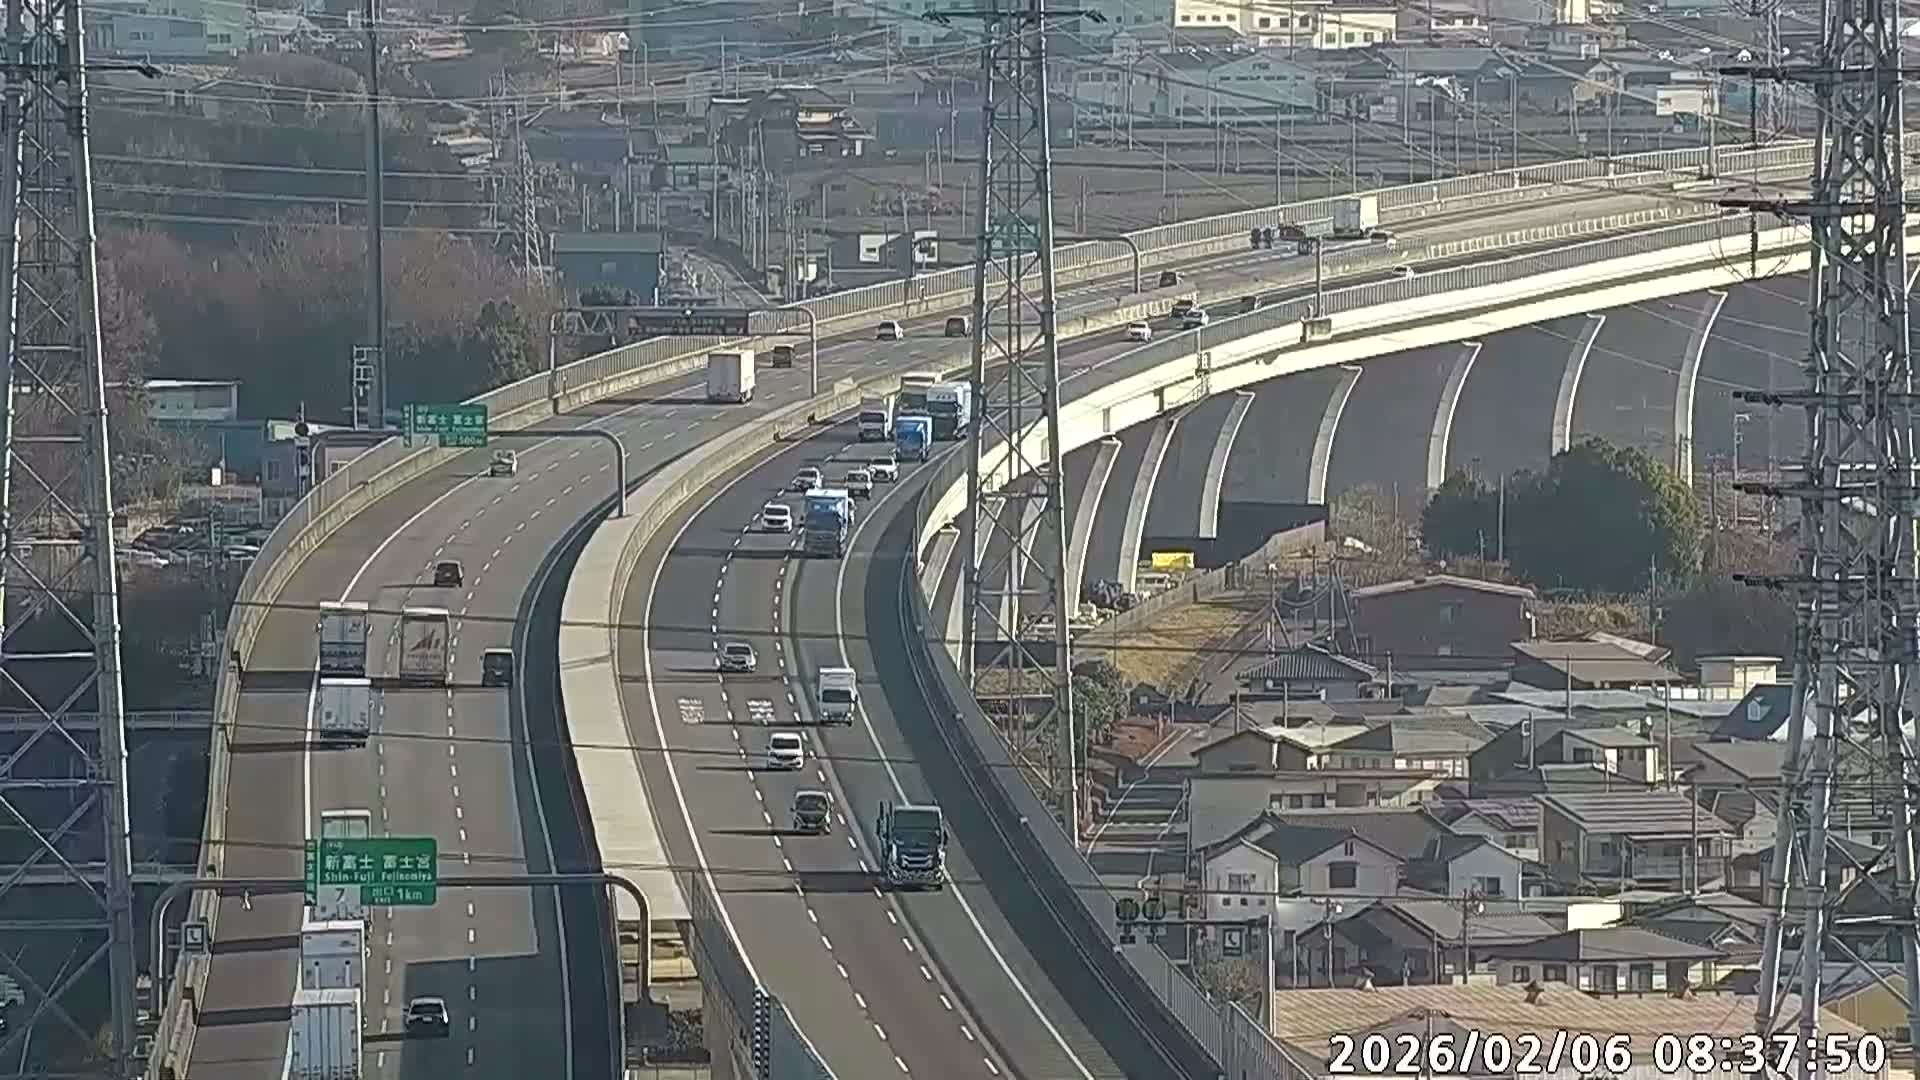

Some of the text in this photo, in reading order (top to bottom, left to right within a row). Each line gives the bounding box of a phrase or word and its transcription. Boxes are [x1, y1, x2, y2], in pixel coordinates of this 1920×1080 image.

[325, 854, 431, 870] 新富士 富士宮
[396, 888, 422, 900] 1km
